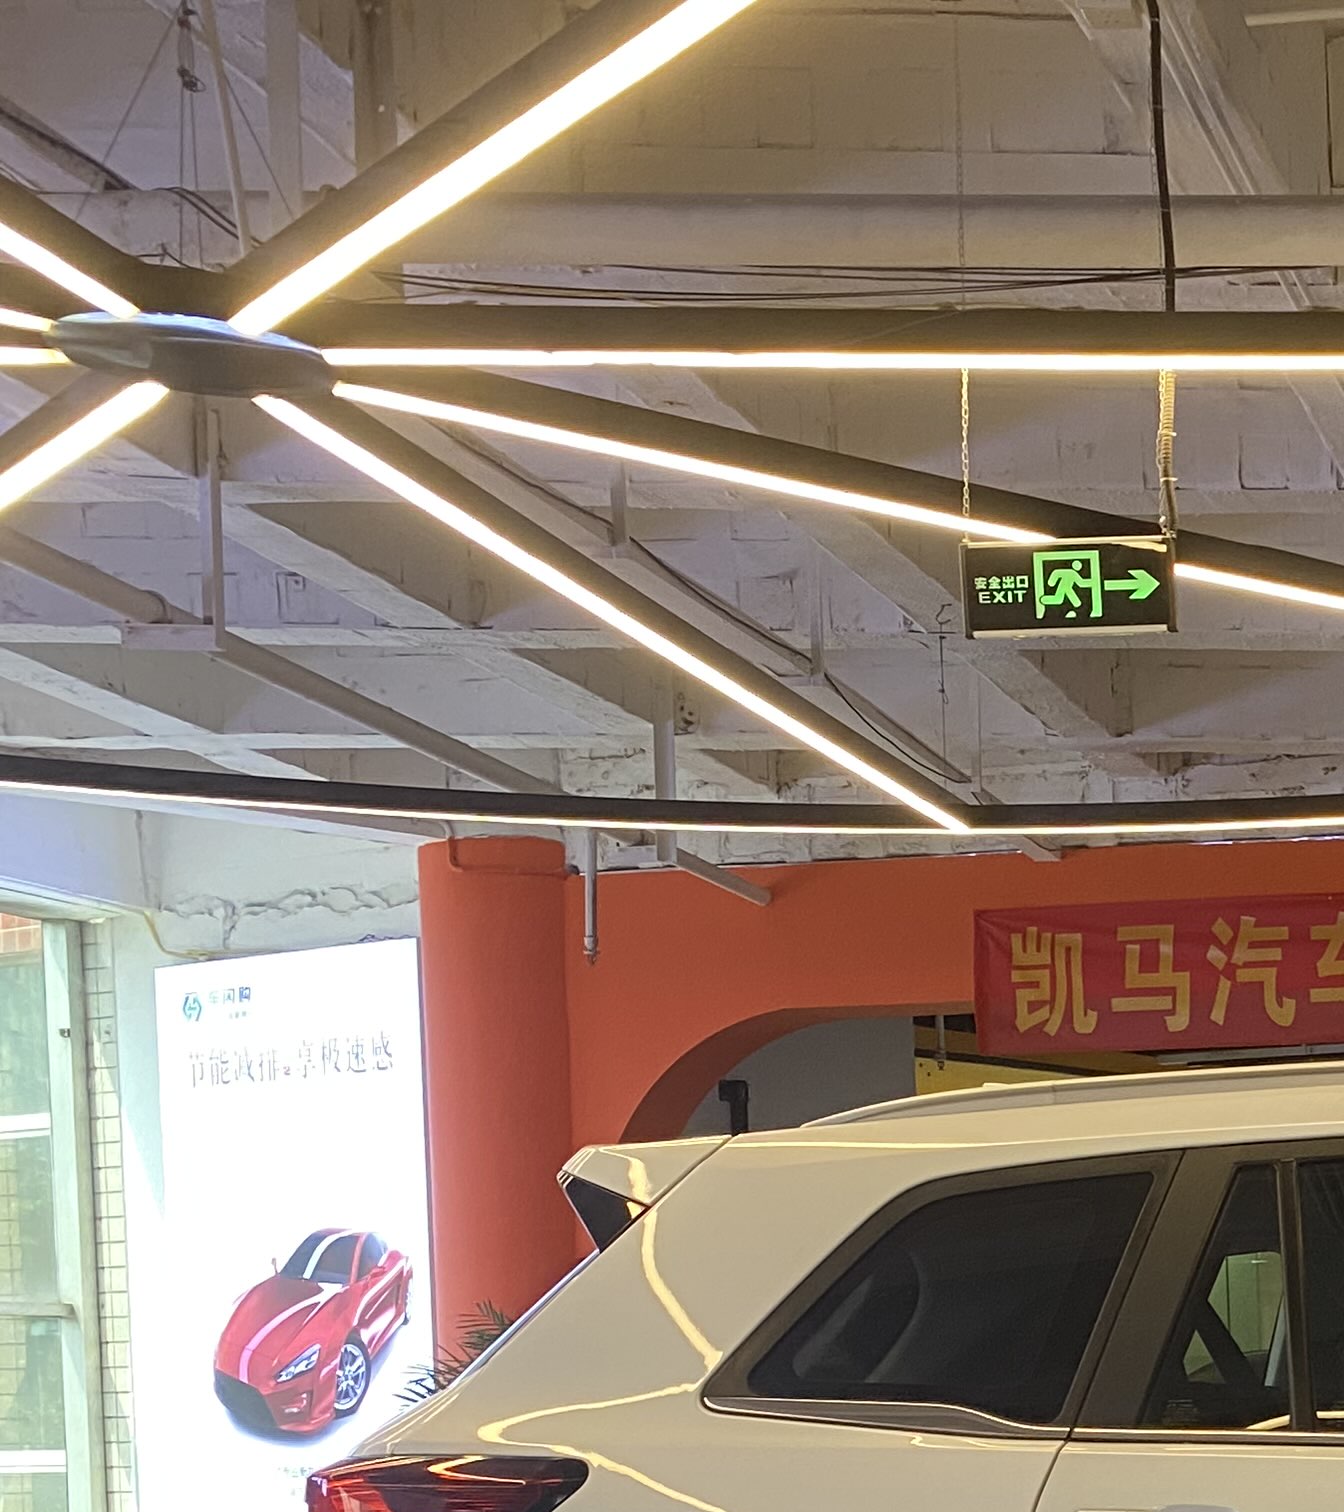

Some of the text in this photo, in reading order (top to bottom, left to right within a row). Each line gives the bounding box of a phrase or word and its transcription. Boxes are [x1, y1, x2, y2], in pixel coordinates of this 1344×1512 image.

[974, 575, 1029, 590] 安全出口
[978, 590, 1027, 604] EXIT
